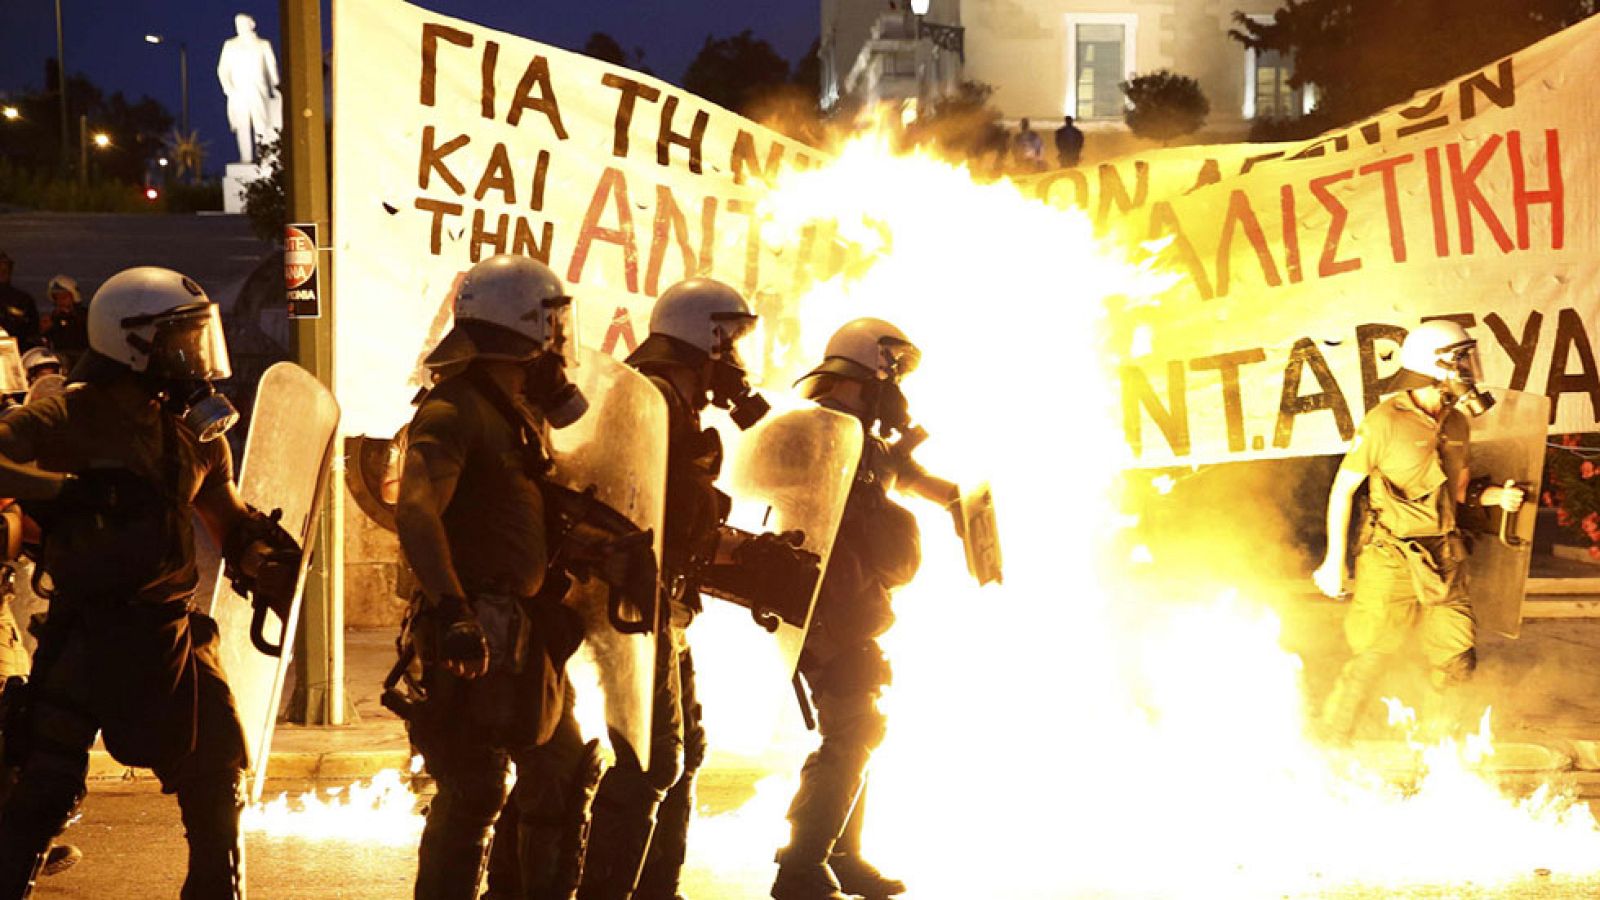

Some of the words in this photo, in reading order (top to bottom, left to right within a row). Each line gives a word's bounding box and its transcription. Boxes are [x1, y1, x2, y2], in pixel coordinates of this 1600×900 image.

[420, 22, 569, 140] ΓΙΑ
[601, 72, 710, 174] ΤΗ
[418, 125, 551, 211] ΚΑΙ
[414, 197, 553, 265] ΤΗΝ
